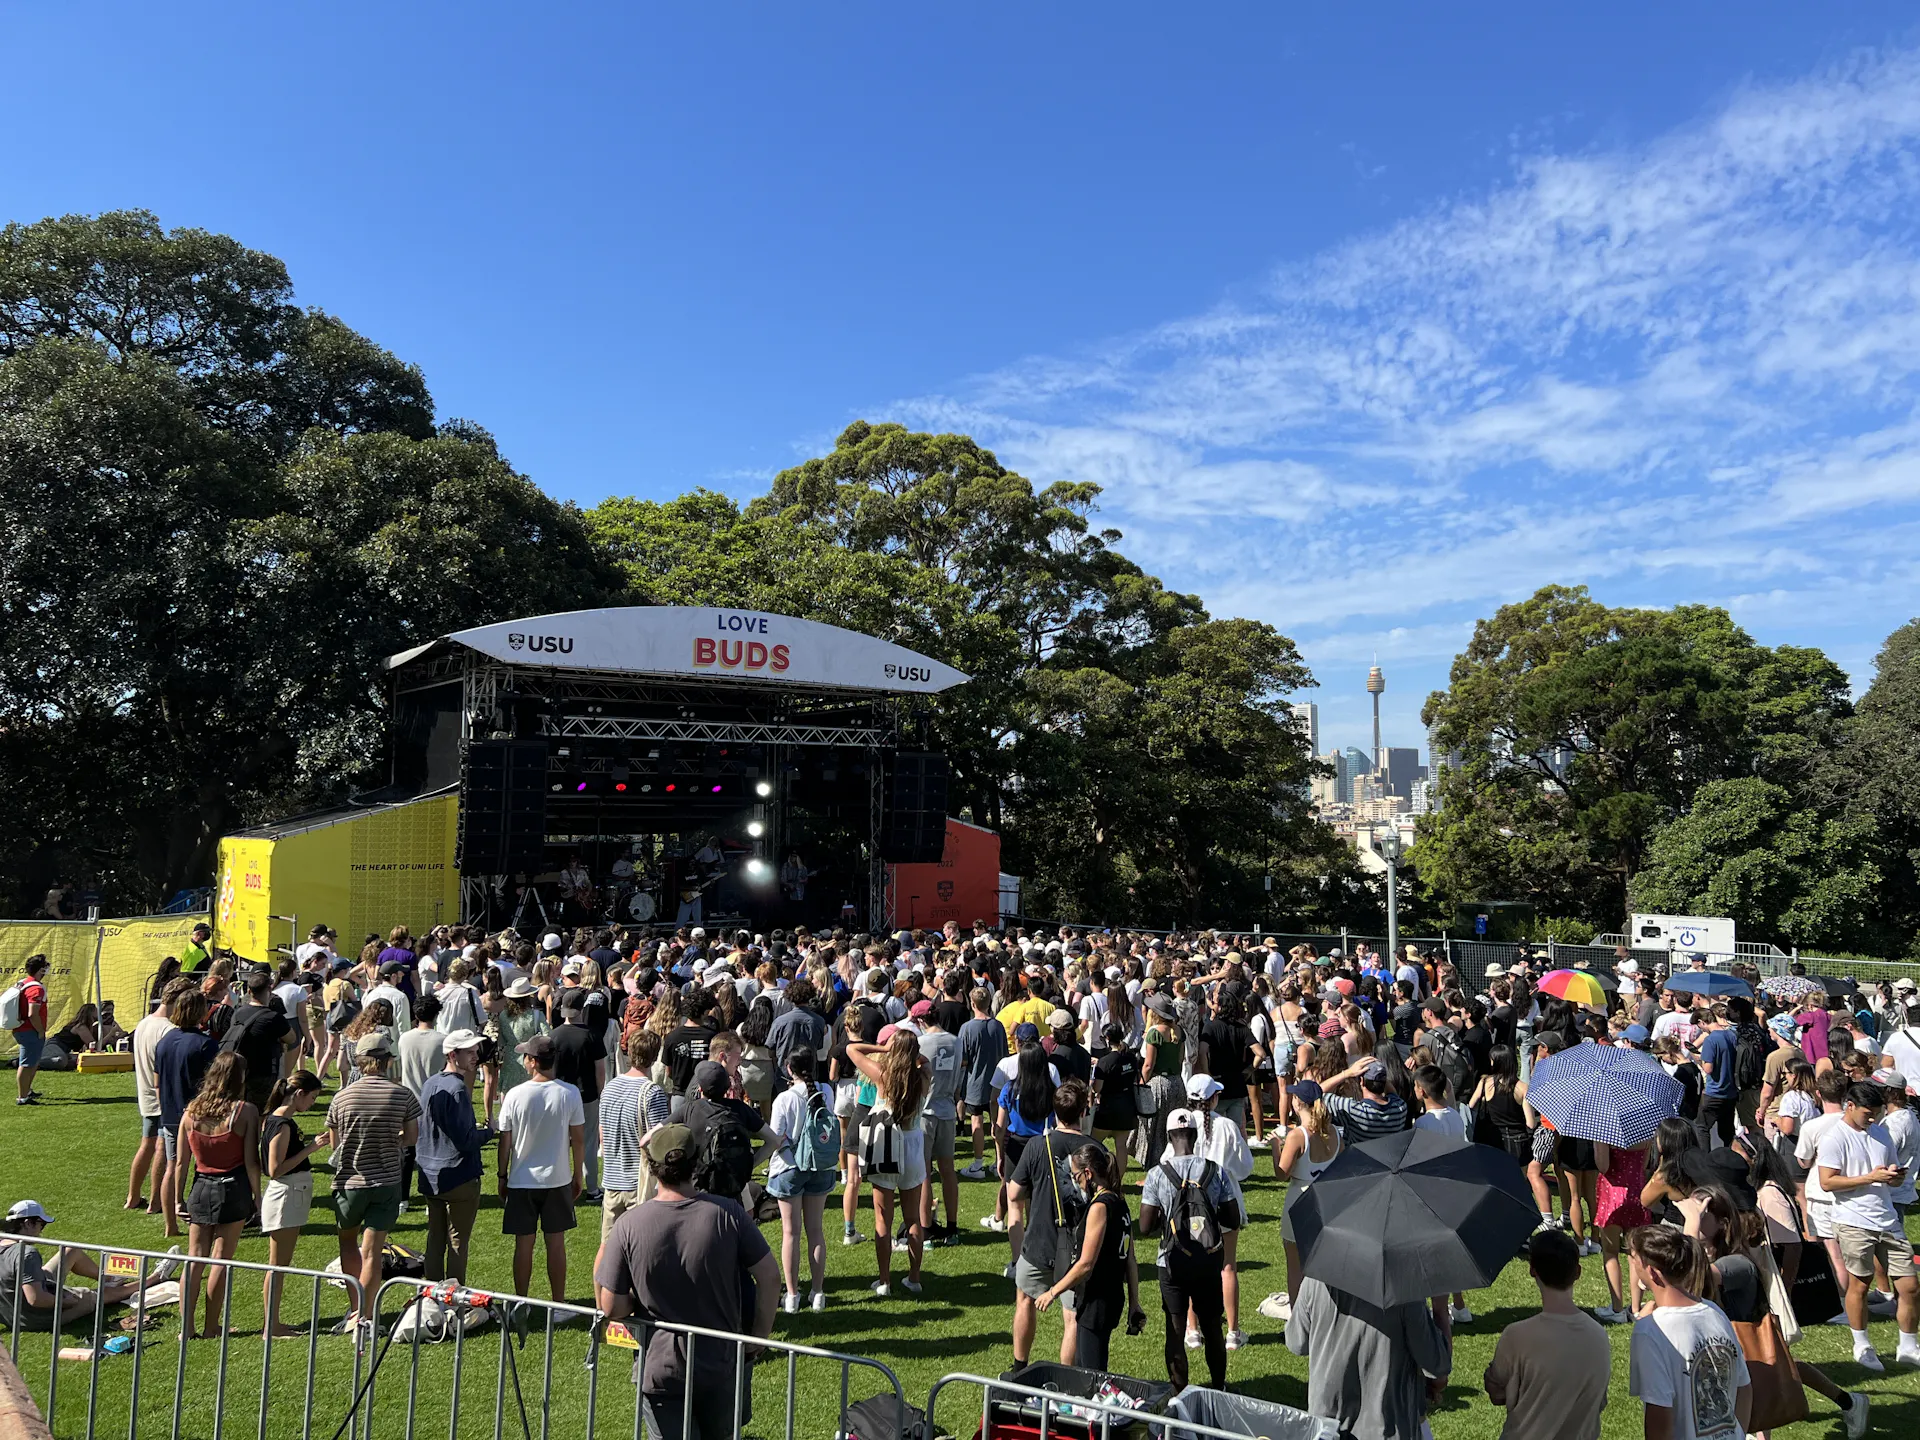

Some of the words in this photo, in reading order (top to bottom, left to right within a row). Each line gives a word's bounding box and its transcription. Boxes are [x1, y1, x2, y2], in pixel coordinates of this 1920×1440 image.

[718, 615, 768, 634] LOVE
[528, 635, 573, 654] USU
[693, 637, 790, 673] BUDS
[898, 666, 931, 682] USU
[245, 873, 262, 889] BUDS
[930, 908, 961, 919] SYDNEY
[111, 1256, 137, 1270] TFH
